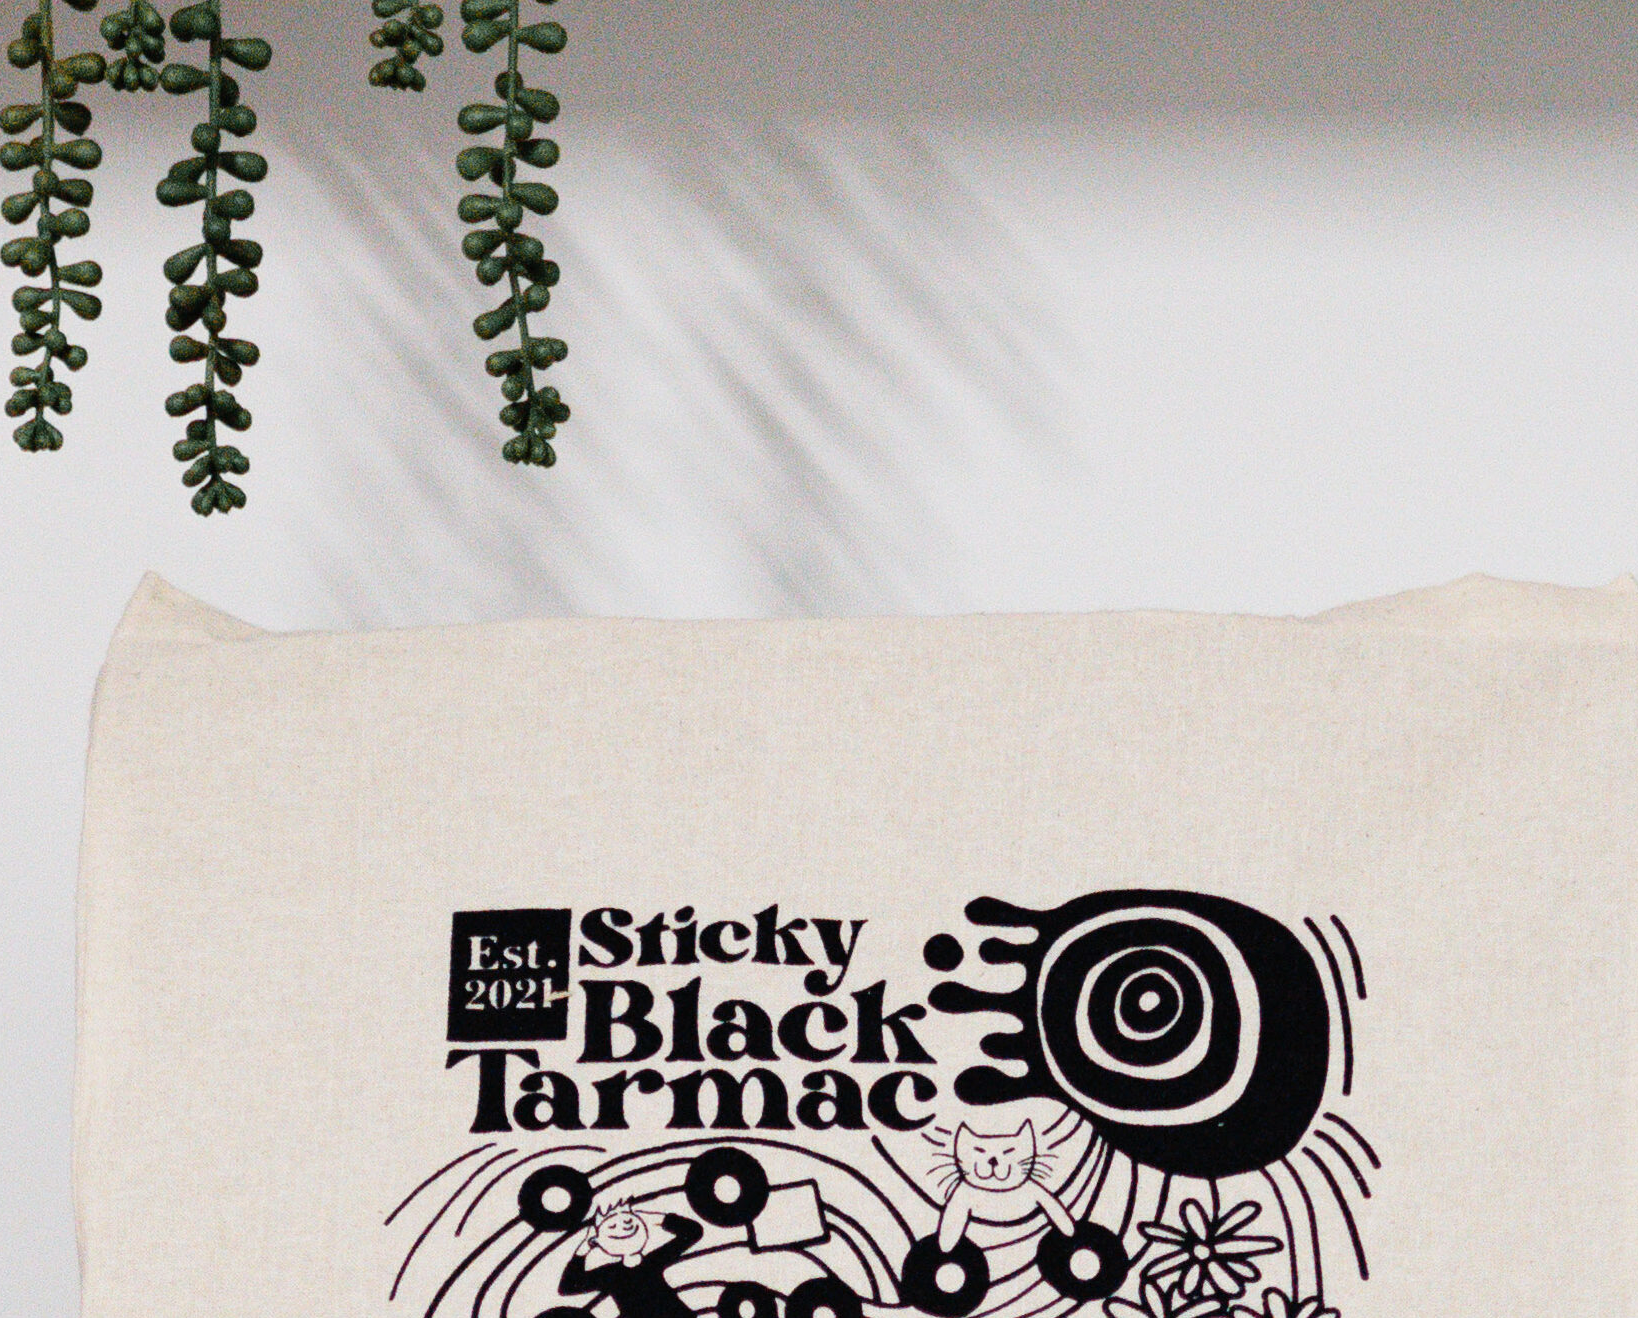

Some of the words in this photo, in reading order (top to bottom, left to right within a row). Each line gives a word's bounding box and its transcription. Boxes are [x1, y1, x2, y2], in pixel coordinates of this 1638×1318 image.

[468, 934, 557, 971] Est.
[576, 904, 869, 991] Sticky
[465, 978, 555, 1012] 2021
[585, 978, 937, 1067] Black
[447, 1047, 941, 1135] Tarmac
